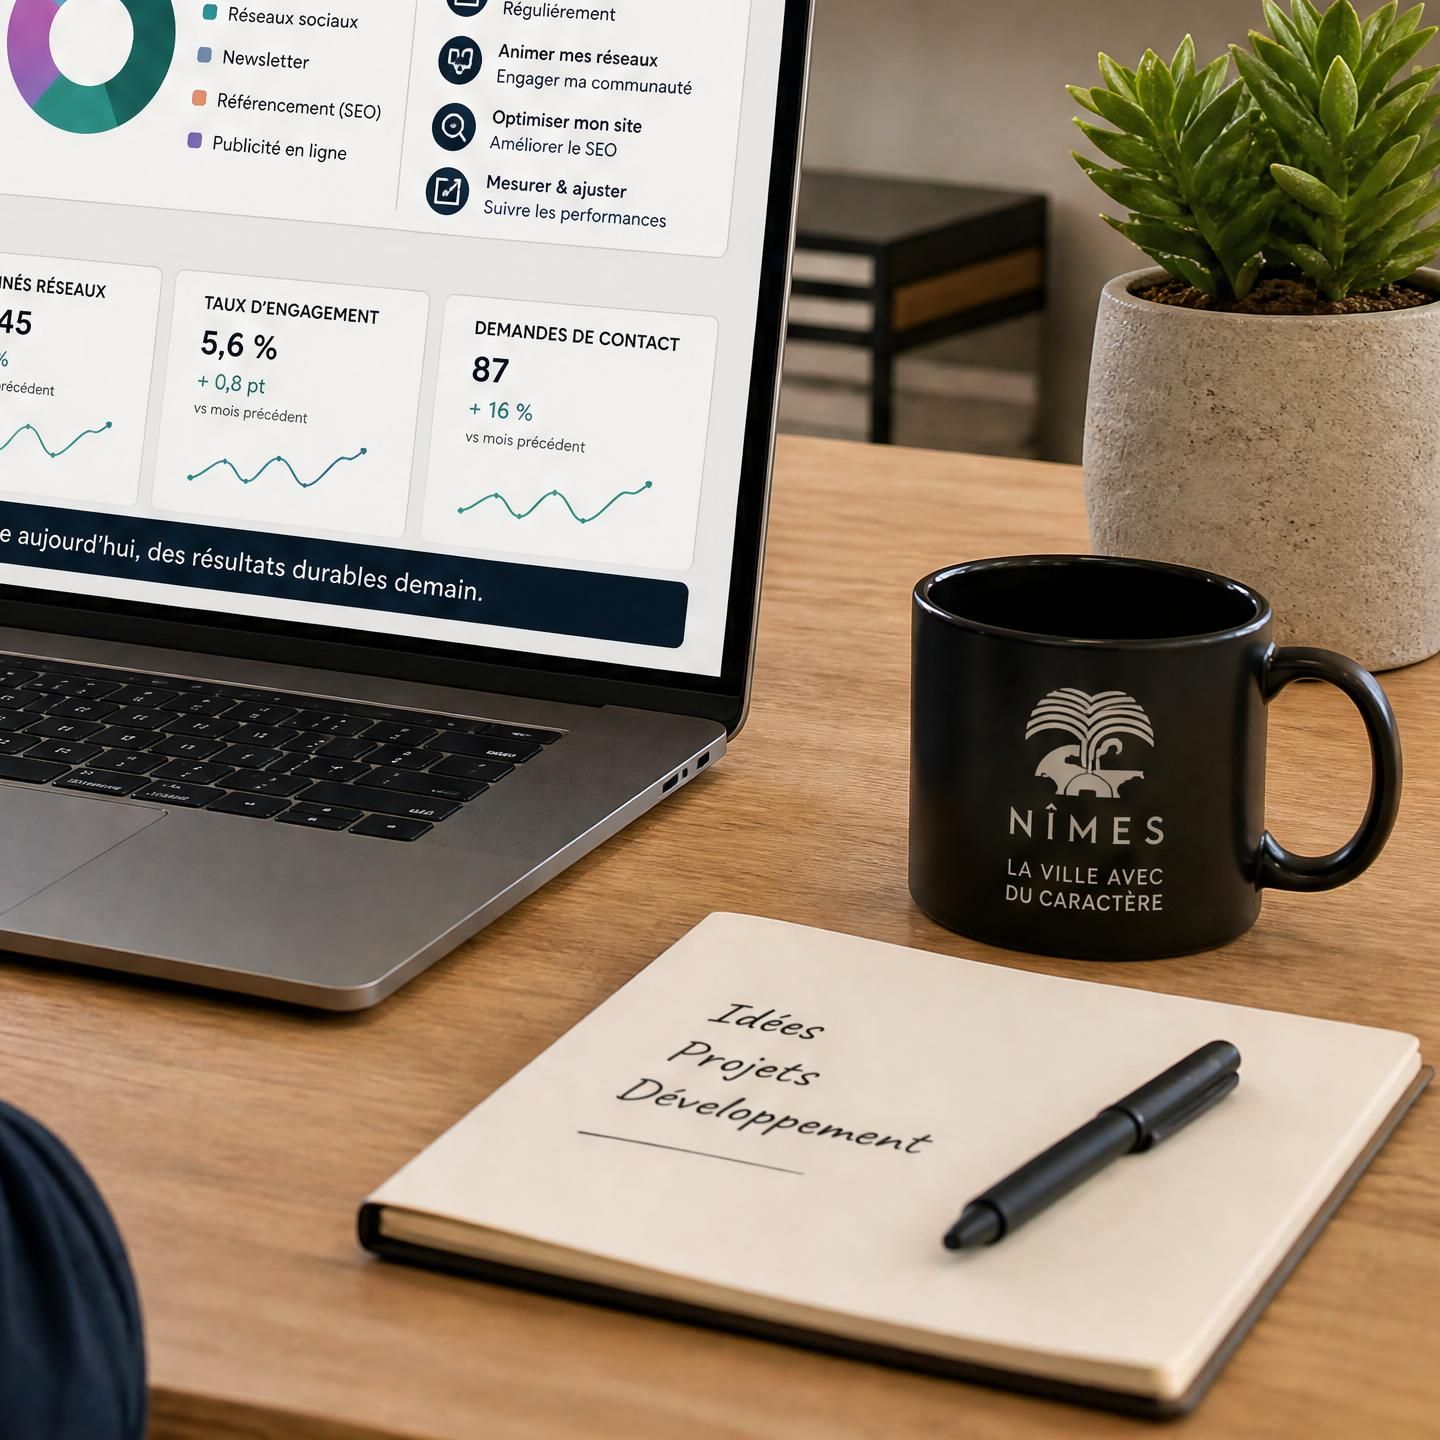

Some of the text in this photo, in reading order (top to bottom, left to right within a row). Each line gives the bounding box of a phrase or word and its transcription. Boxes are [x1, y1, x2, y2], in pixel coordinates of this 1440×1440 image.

[228, 6, 359, 29] Réseaux sociaux
[222, 49, 310, 70] Newsletter
[497, 43, 658, 68] Animer mes réseaux
[496, 68, 693, 95] Engager ma communauté
[217, 92, 381, 122] Référencement (SEO)
[492, 109, 643, 134] Optimiser mon site
[212, 135, 347, 163] Publicité en ligne
[489, 135, 618, 158] Améliorer le SEO
[486, 174, 628, 200] Mesurer & ajuster
[483, 199, 667, 228] Suivre les performances
[36, 276, 107, 299] RÉSEAUX
[204, 295, 247, 313] TAUX
[200, 329, 278, 361] 5,6 %
[474, 320, 681, 352] DEMANDES DE CONTACT
[472, 355, 510, 384] 87
[197, 373, 266, 398] + 0,8 pt
[193, 404, 308, 425] vs mois précédent
[469, 401, 533, 422] + 16 %
[465, 432, 586, 454] vs mois précédent
[147, 541, 186, 565] des
[192, 547, 286, 577] résultats
[292, 558, 388, 590] durables
[394, 571, 483, 602] demain.
[1009, 802, 1164, 845] NÎMES
[1007, 858, 1163, 886] LA VILLE AVEC
[1005, 884, 1163, 912] DU CARACTÈRE
[707, 1003, 825, 1040] Idées
[666, 1040, 821, 1086] Projets
[616, 1078, 933, 1154] Développement
